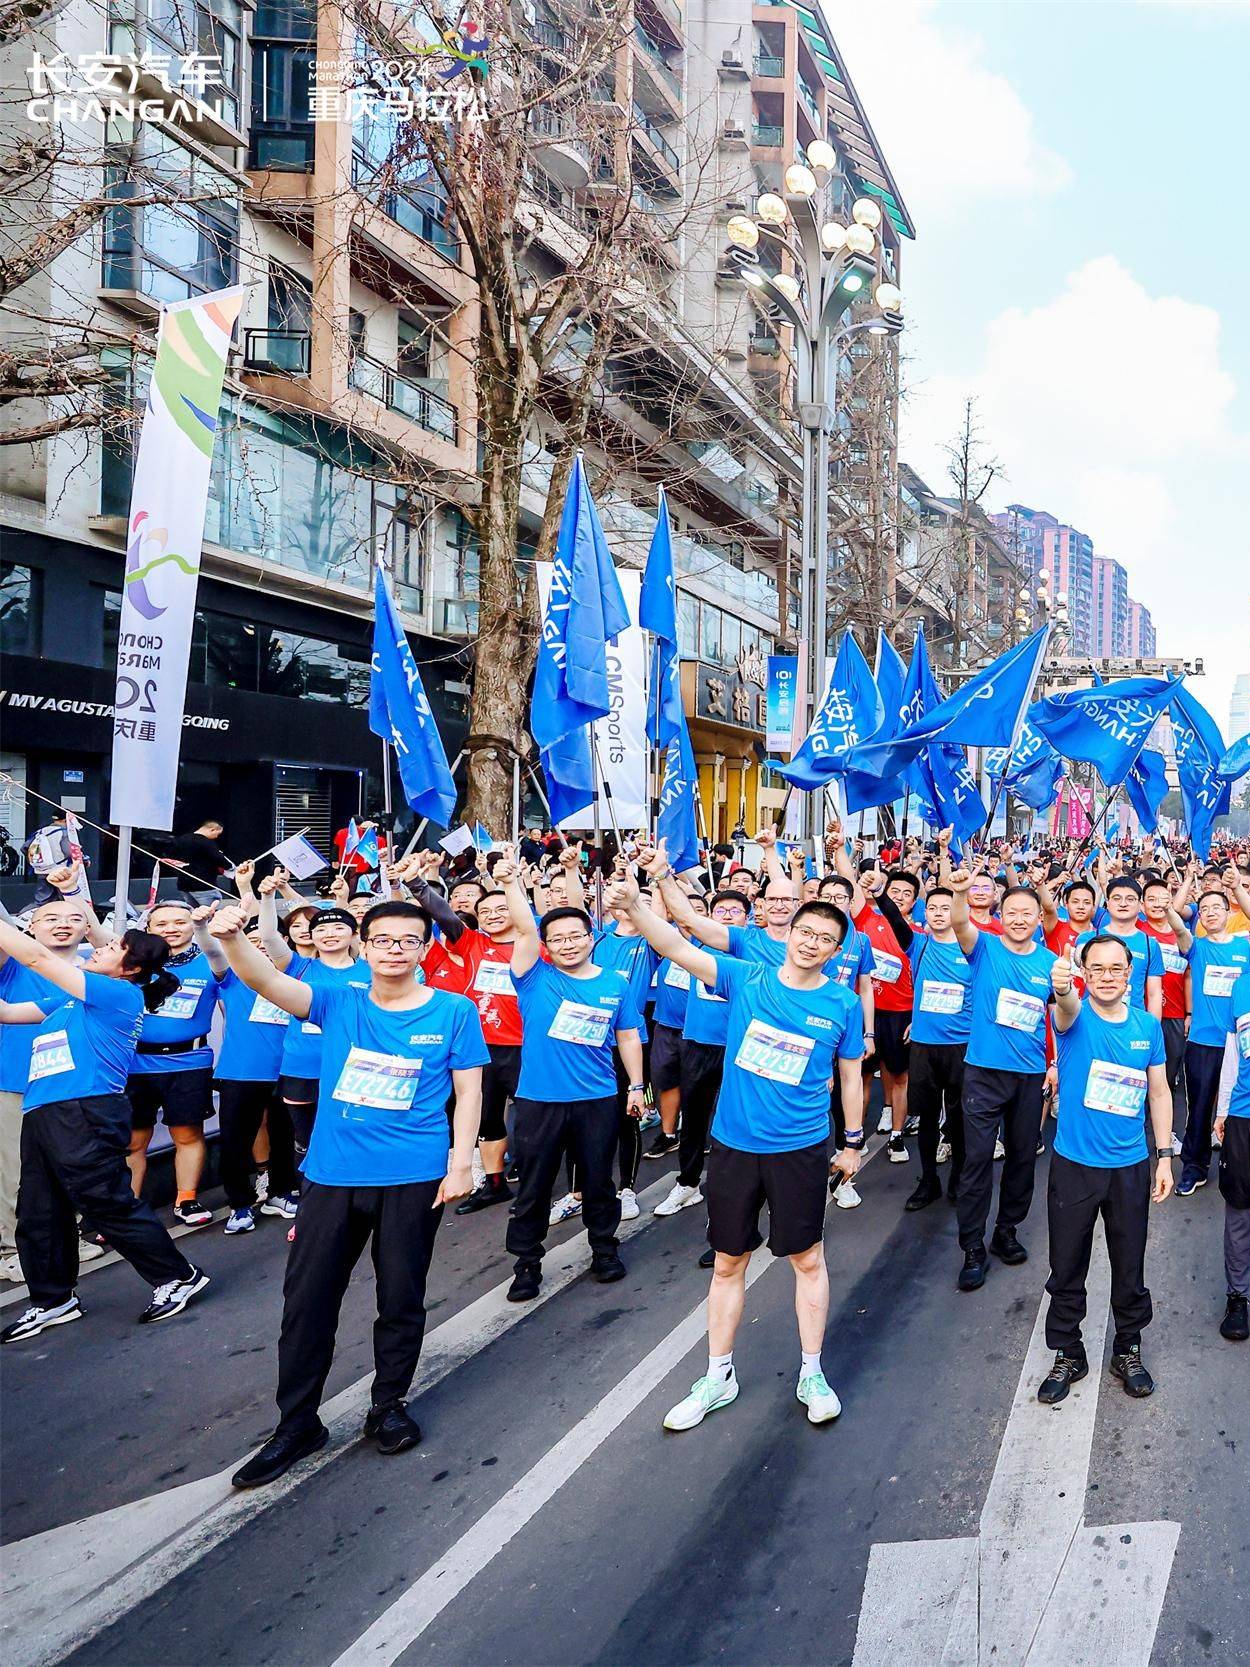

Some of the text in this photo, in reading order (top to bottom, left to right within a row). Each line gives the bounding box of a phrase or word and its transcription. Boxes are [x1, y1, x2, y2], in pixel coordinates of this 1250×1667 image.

[8, 693, 229, 730] MV AGUSTA GQING
[742, 1041, 801, 1076] E72737
[341, 1069, 412, 1101] E72746
